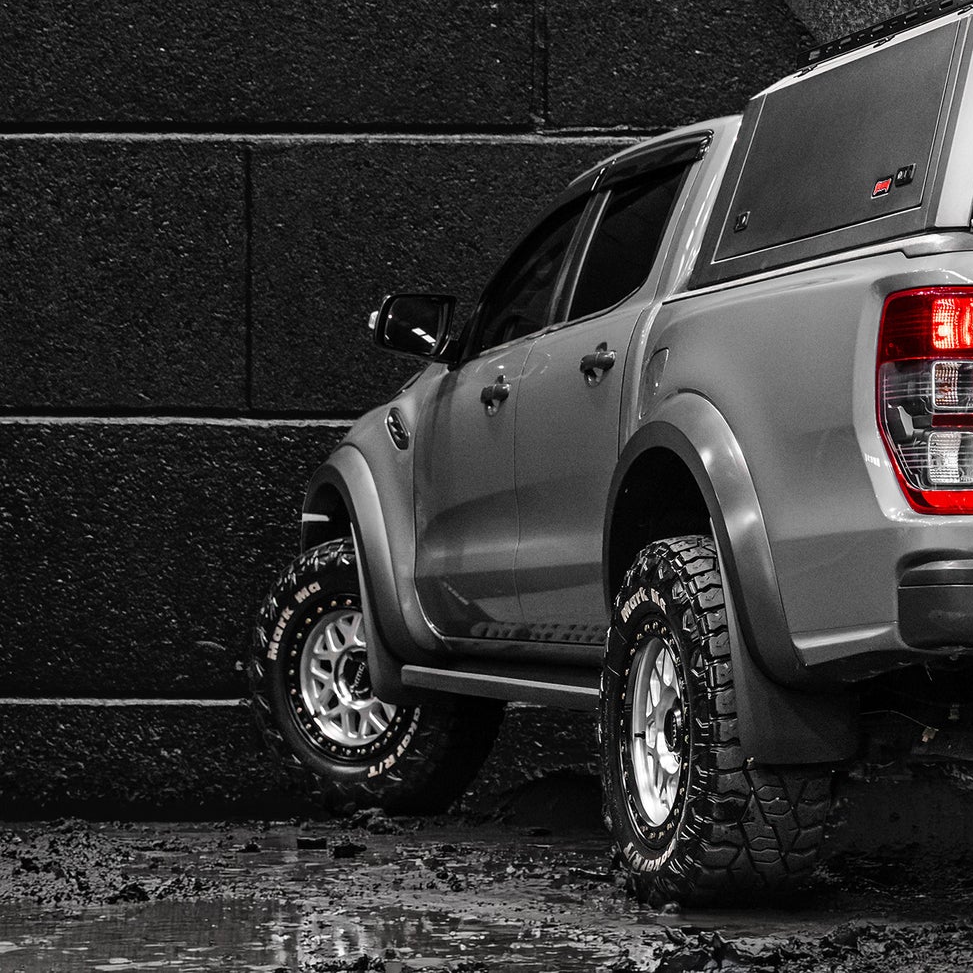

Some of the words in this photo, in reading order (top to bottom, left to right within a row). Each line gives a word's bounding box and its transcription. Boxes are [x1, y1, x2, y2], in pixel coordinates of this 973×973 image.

[620, 587, 649, 623] Mark
[267, 606, 295, 661] Mark
[396, 707, 421, 758] akar
[367, 754, 396, 778] R/T
